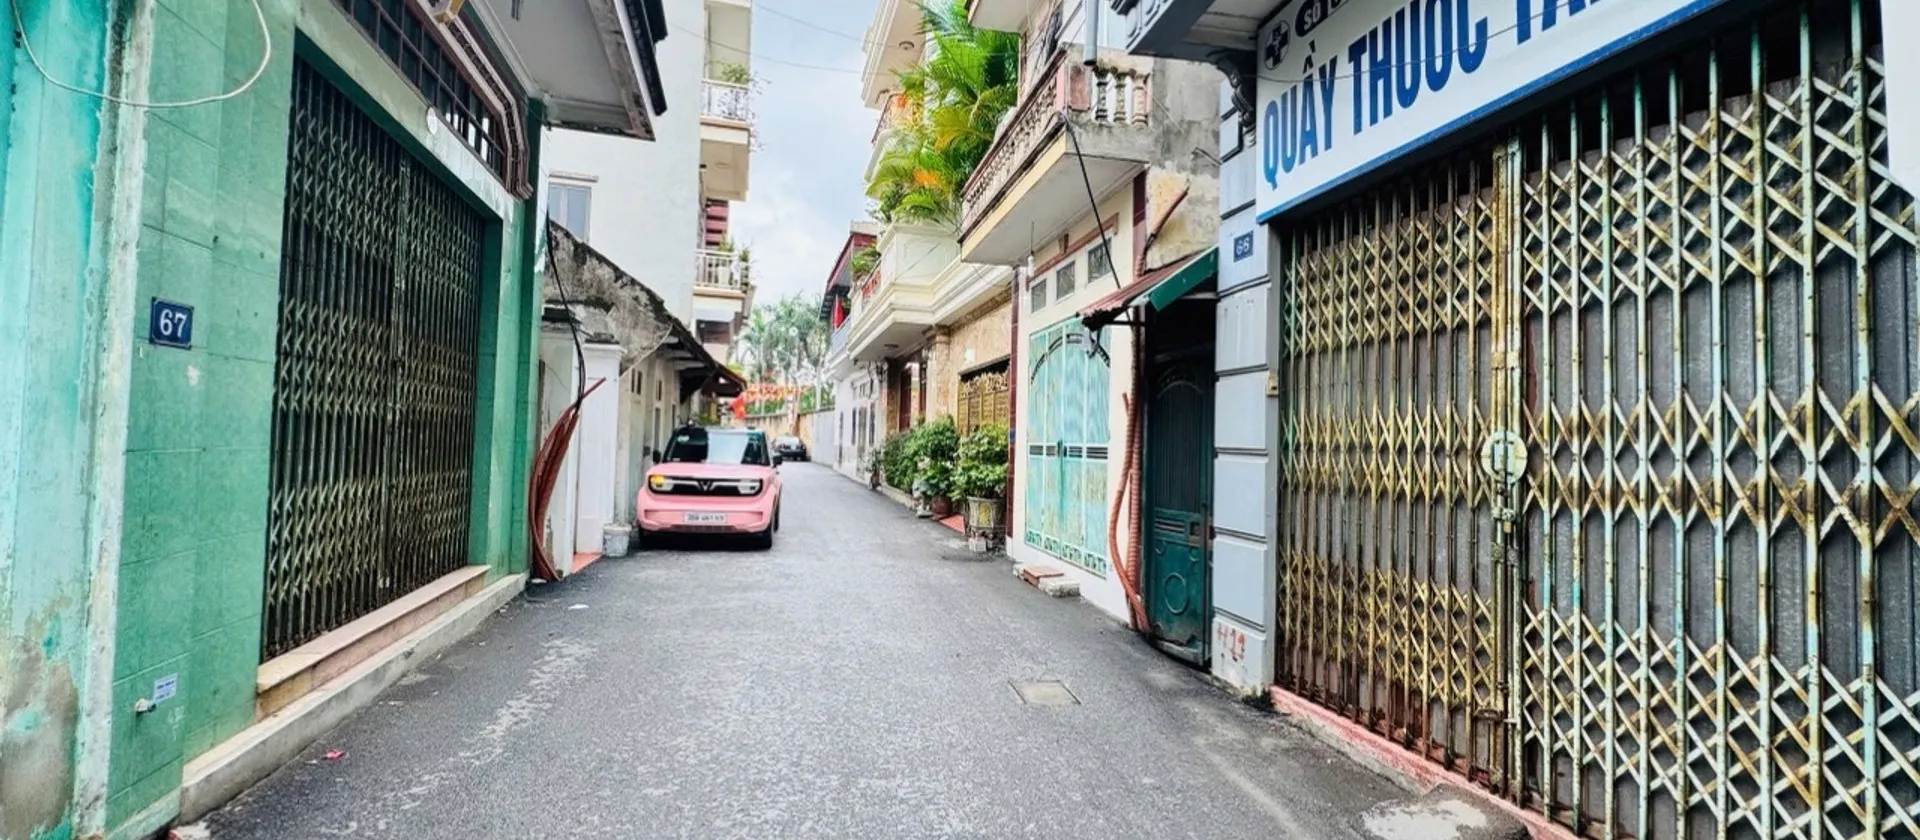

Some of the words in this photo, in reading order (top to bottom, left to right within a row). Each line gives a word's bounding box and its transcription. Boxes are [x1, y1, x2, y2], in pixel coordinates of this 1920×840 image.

[1264, 39, 1338, 190] QUẦY
[1236, 237, 1250, 255] 66
[160, 309, 187, 338] 67
